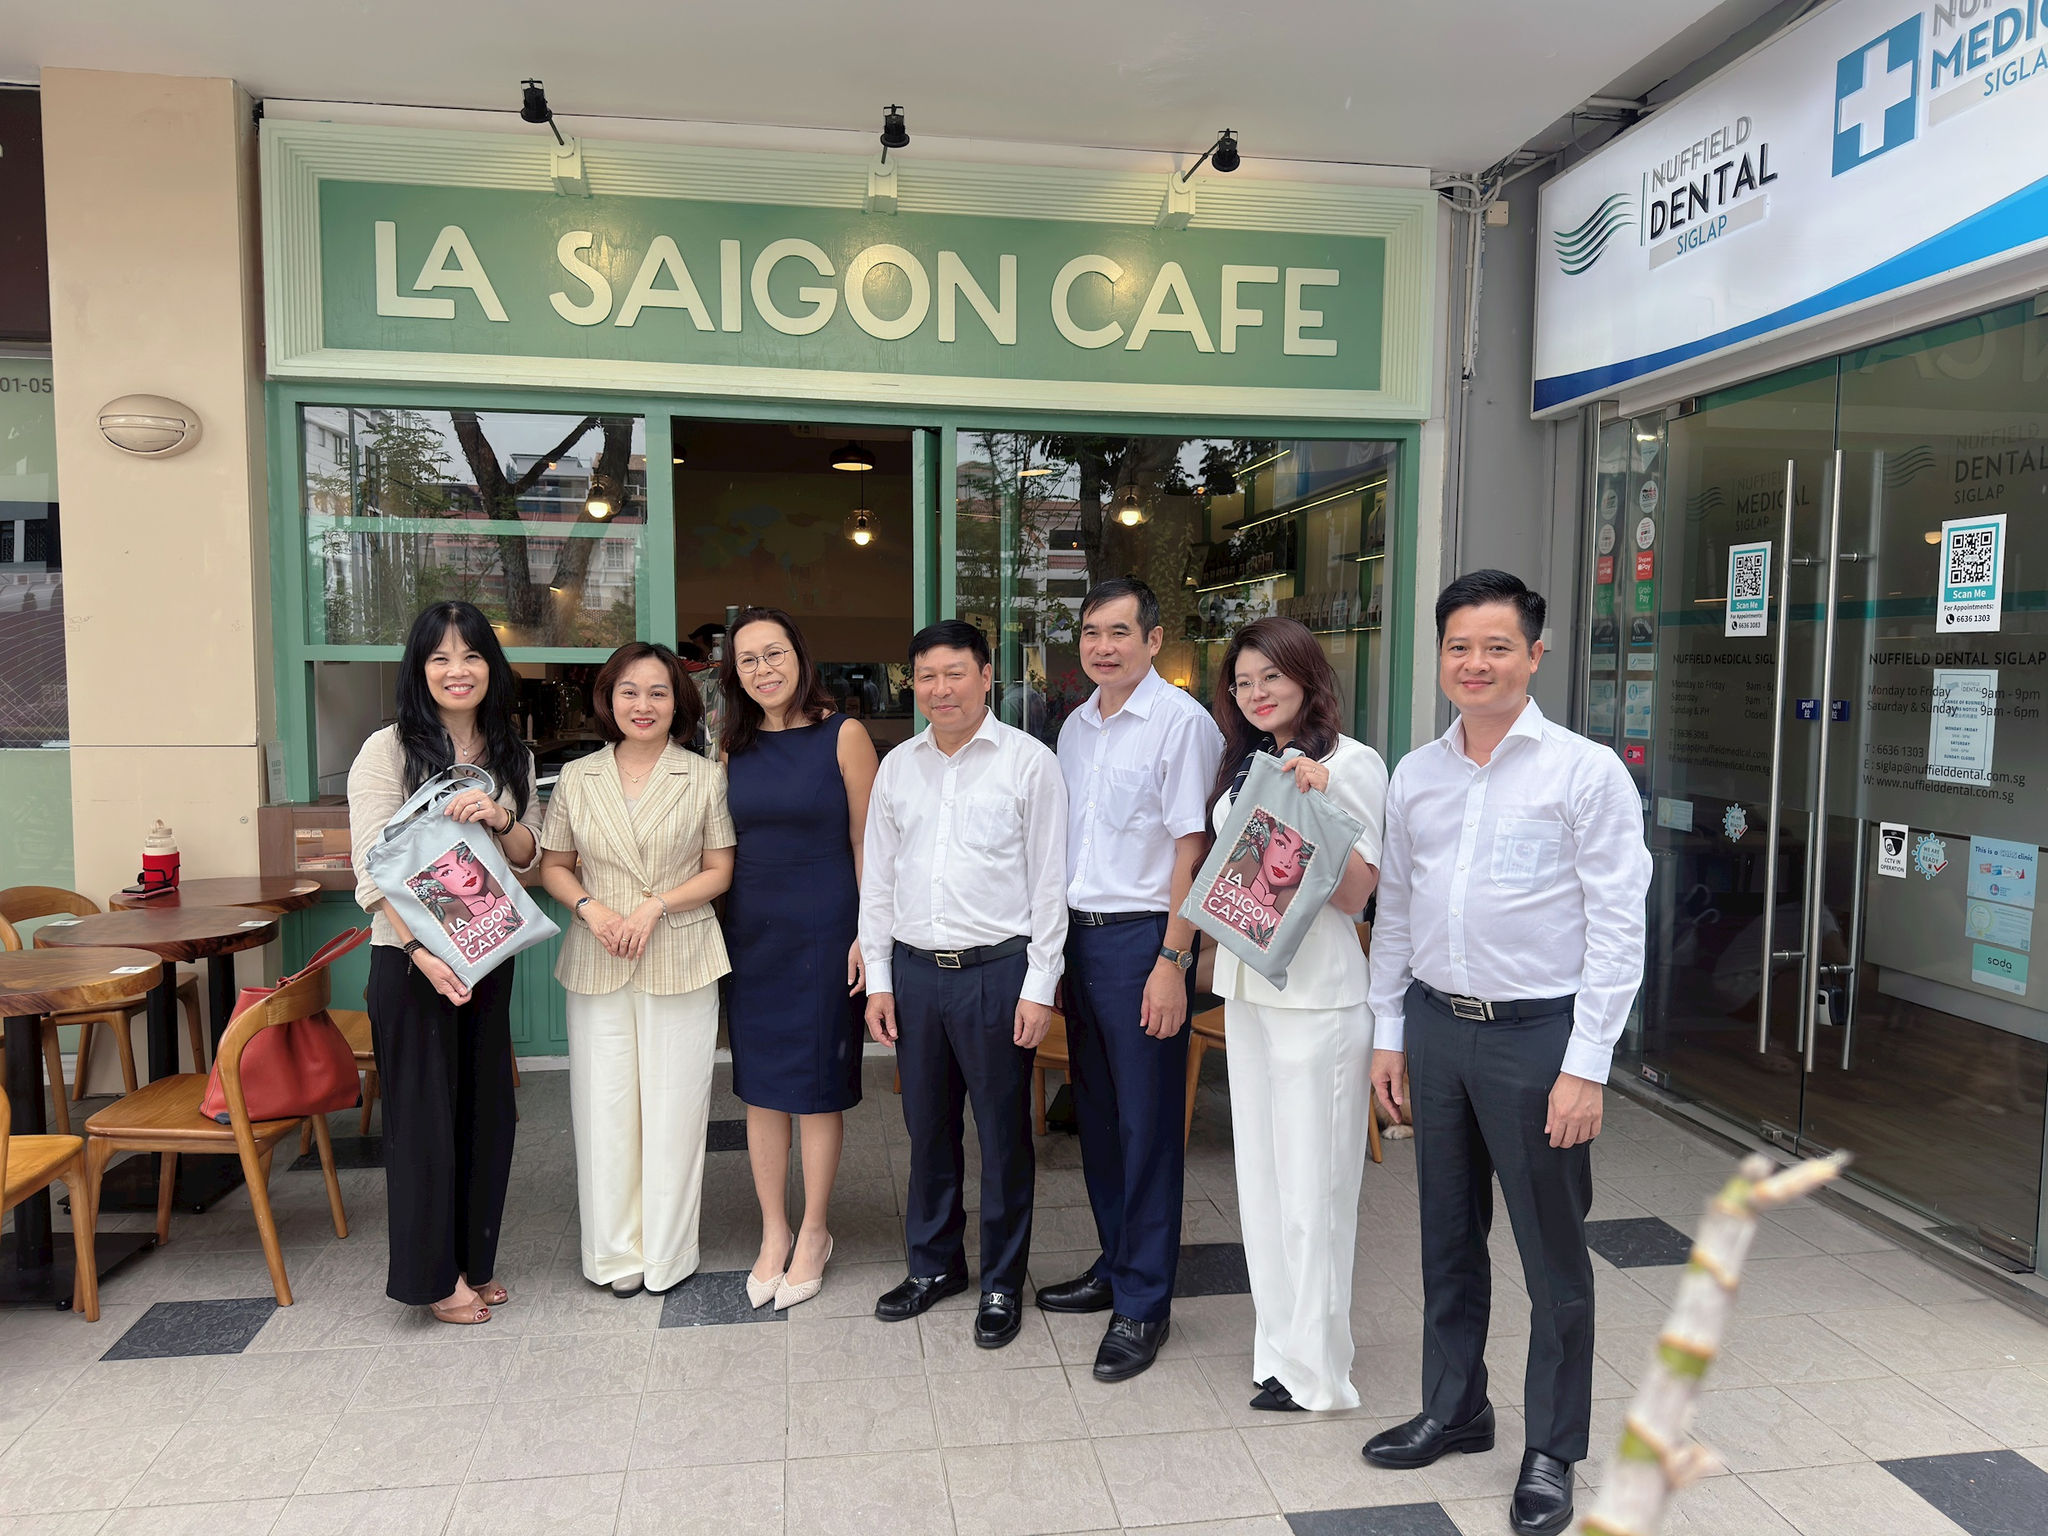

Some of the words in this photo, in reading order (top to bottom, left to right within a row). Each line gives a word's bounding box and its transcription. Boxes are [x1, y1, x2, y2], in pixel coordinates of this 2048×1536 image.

[1652, 116, 1752, 193] NUFFIELD
[1650, 143, 1778, 240] DENTAL
[1677, 215, 1728, 255] SIGLAP
[375, 219, 510, 323] LA
[548, 229, 1018, 345] SAIGON
[1050, 253, 1341, 357] CAFE
[1955, 423, 2040, 450] NUFFIELD
[1955, 445, 2048, 484] DENTAL
[1737, 471, 1785, 490] NUFFIEL
[1954, 484, 2005, 505] SIGLAP
[1736, 516, 1770, 532] SIGLAP
[1638, 586, 1651, 595] Grab
[1953, 589, 1973, 600] Scan
[1974, 588, 1986, 598] Me
[1639, 595, 1650, 603] Pay
[1736, 601, 1750, 609] Scan
[1953, 603, 1994, 612] Appointments:
[1956, 614, 1973, 623] 6636
[1974, 614, 1991, 622] 1303
[1673, 654, 1712, 665] NUFFIELD
[1714, 654, 1752, 665] MEDICAL
[1869, 652, 1931, 665] NUFFIELD
[1935, 652, 1989, 665] DENTAL
[1994, 651, 2048, 665] SIGLAP
[1705, 680, 1725, 691] Friday
[1745, 682, 1761, 691] 9am
[1868, 684, 1905, 699] Monday
[1907, 686, 1917, 696] to
[1920, 685, 1951, 700] Friday
[1981, 687, 2005, 699] 9am
[2015, 689, 2041, 701] 9pm
[1801, 700, 1814, 710] pull
[1832, 701, 1842, 710] ull
[1867, 701, 1909, 714] Saturday
[1910, 703, 1919, 712] &
[1920, 703, 1959, 717] Sunday
[1980, 704, 2005, 716] 9am
[2014, 706, 2040, 720] 6pm
[1744, 709, 1768, 720] Closed
[1877, 744, 1902, 756] 6636
[1902, 746, 1924, 758] 1303
[1876, 761, 2026, 787] siglap@nuffielddental.com.sg
[1877, 778, 2015, 804] www.nuffielddental.com.sg
[1922, 856, 1939, 864] READY
[1975, 846, 1987, 854] This
[2018, 853, 2033, 861] clinic
[1880, 864, 1905, 873] OPERATION
[1224, 868, 1243, 889] LA
[1214, 882, 1277, 928] SAIGON
[1208, 897, 1251, 931] CAFE
[449, 917, 470, 934] LA
[456, 900, 513, 947] SAIGON
[465, 924, 506, 958] CAFE
[1987, 957, 2012, 970] soda
